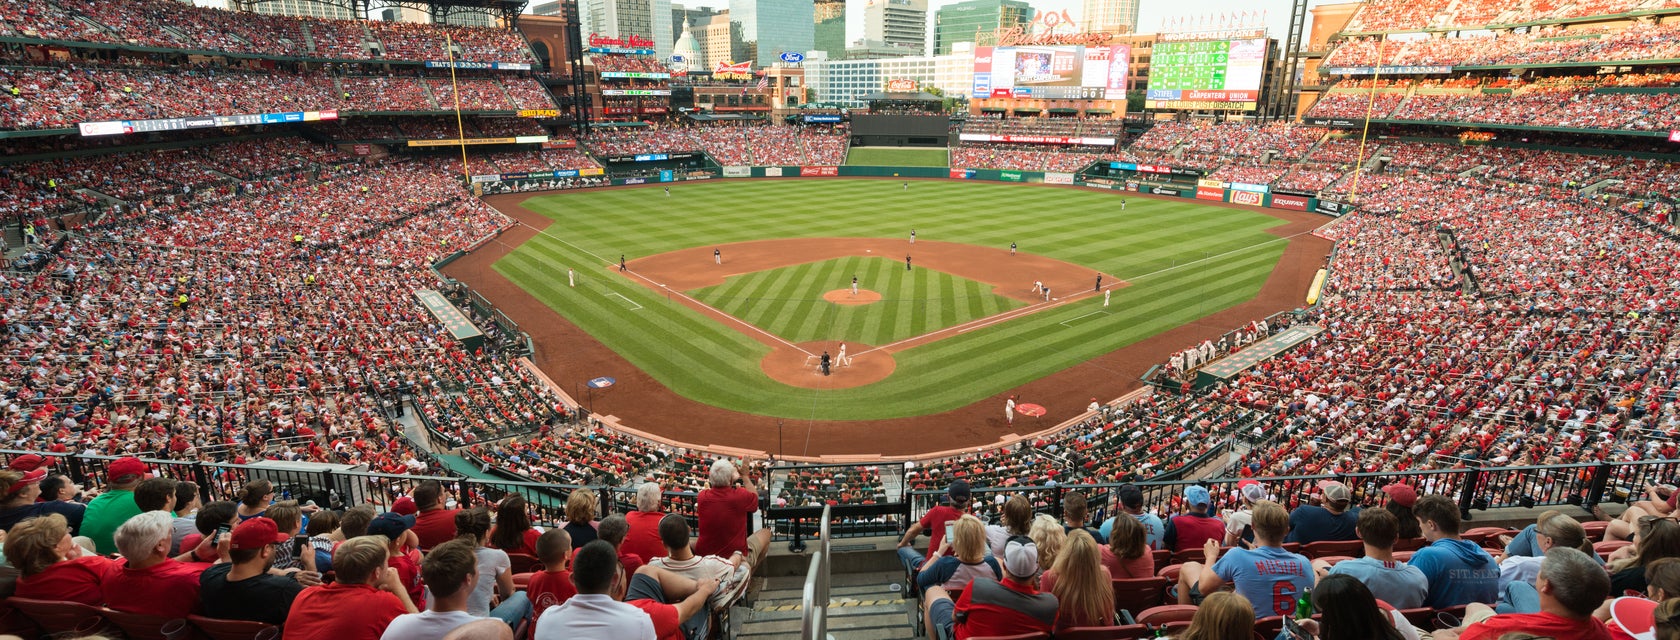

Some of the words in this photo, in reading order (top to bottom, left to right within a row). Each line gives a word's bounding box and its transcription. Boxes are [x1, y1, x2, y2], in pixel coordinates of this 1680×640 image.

[994, 25, 1113, 47] Budweiser
[1165, 32, 1195, 41] WORLD
[1199, 30, 1255, 39] CHAMPIONS
[785, 53, 800, 61] Ford
[1274, 198, 1304, 207] EQUIFAX
[1272, 580, 1296, 616] 6
